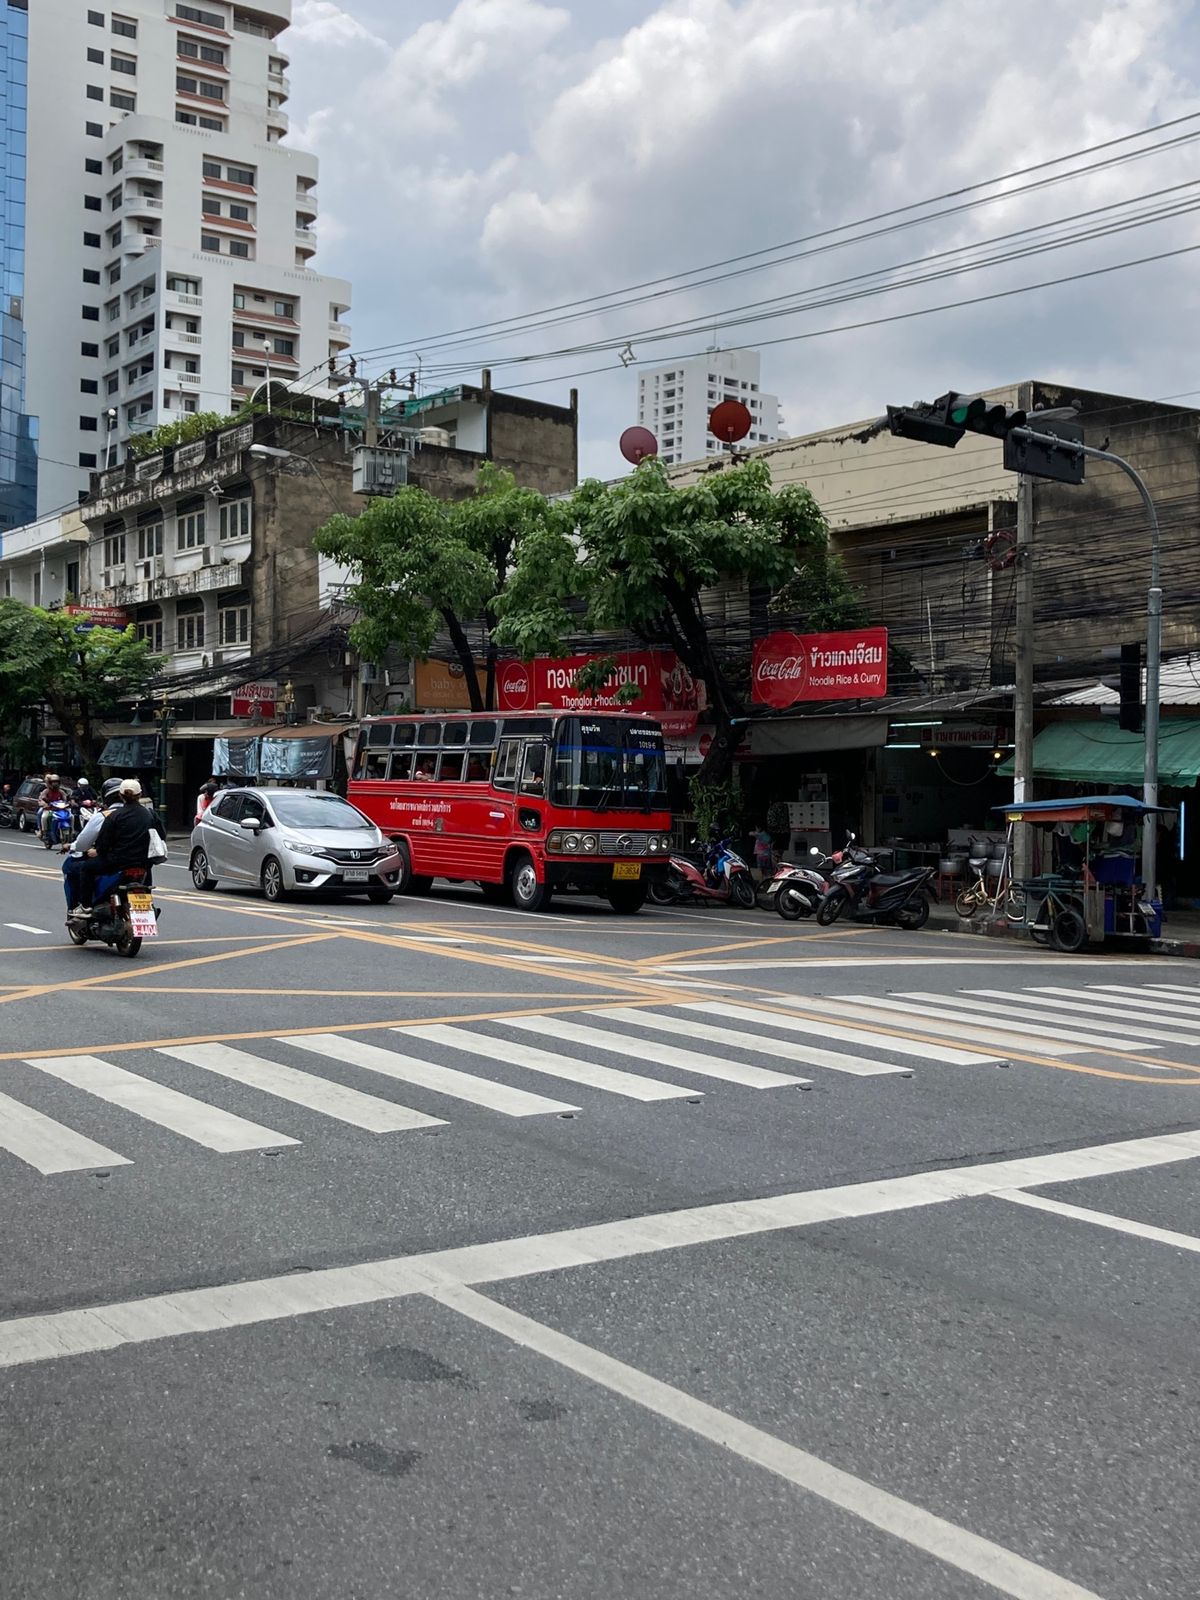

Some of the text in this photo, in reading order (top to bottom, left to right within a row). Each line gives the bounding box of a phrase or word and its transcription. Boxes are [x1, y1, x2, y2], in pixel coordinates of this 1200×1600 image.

[810, 643, 882, 668] ข้าวแกงเจ๊สม
[757, 657, 805, 681] Coca-Cola
[504, 679, 527, 693] Coca-Cola
[809, 672, 881, 686] Noodle Rice & Curry
[561, 694, 632, 709] Thonglor Phocha
